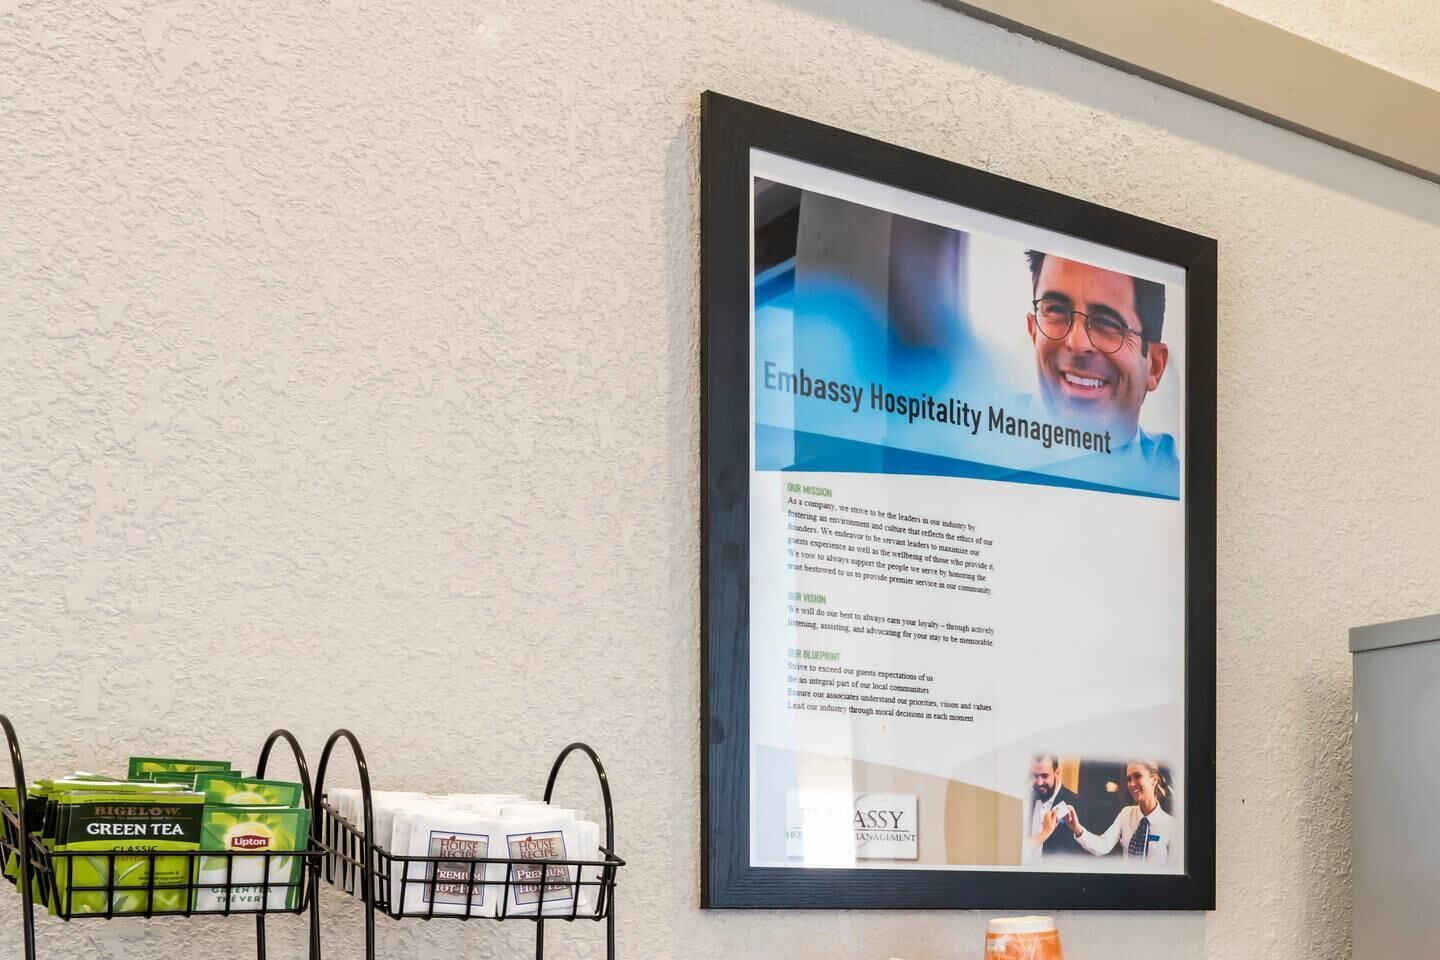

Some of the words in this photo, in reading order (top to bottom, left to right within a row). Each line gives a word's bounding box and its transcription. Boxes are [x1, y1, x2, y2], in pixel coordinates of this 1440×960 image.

[764, 361, 863, 413] Embassy
[870, 382, 982, 435] Hospitality
[988, 405, 1112, 454] Management
[787, 484, 801, 494] OUR
[803, 486, 833, 496] MISSION
[788, 496, 797, 504] As
[851, 507, 868, 515] strive
[878, 509, 885, 518] be
[887, 511, 897, 519] the
[898, 513, 921, 523] leaders
[942, 520, 967, 531] industry
[829, 517, 870, 528] environment
[871, 522, 883, 530] and
[884, 524, 906, 533] culture
[908, 527, 920, 535] that
[921, 529, 944, 539] reflects
[946, 532, 955, 540] the
[956, 534, 974, 543] ethics
[834, 530, 863, 540] endeavor
[882, 538, 906, 546] servant
[907, 539, 930, 549] leaders
[939, 545, 968, 554] maximize
[810, 540, 846, 550] experience
[856, 546, 871, 554] well
[880, 548, 890, 556] the
[892, 550, 923, 563] wellbeing
[933, 555, 949, 564] those
[950, 558, 963, 566] who
[964, 561, 988, 569] provide
[804, 564, 836, 575] bestowed
[863, 573, 888, 581] provide
[889, 576, 914, 584] premier
[826, 554, 849, 565] always
[851, 559, 874, 567] support
[876, 560, 886, 568] the
[887, 563, 909, 572] people
[948, 570, 975, 582] honoring
[803, 593, 826, 603] VISION
[801, 607, 814, 615] will
[839, 611, 853, 619] best
[863, 613, 885, 624] always
[902, 619, 917, 627] your
[918, 619, 939, 630] loyalty
[946, 622, 970, 633] through
[971, 626, 994, 636] actively
[866, 626, 901, 639] advocating
[902, 630, 912, 638] for
[929, 634, 941, 643] stay
[803, 650, 840, 661] BLUEPRINT
[818, 666, 842, 674] exceed
[878, 672, 917, 680] expectations
[809, 677, 835, 687] integral
[872, 682, 888, 690] local
[890, 685, 929, 693] communities
[826, 693, 859, 701] associates
[861, 694, 896, 703] understand
[973, 703, 992, 711] values
[820, 704, 847, 714] industry
[849, 706, 874, 716] through
[895, 709, 924, 718] decisions
[86, 823, 147, 835] GREEN
[150, 823, 184, 835] TEA
[234, 838, 266, 846] Lipton
[440, 840, 478, 851] HOUSE
[519, 839, 554, 851] HOUSE
[520, 849, 556, 859] RECIPE
[519, 885, 541, 894] HO
